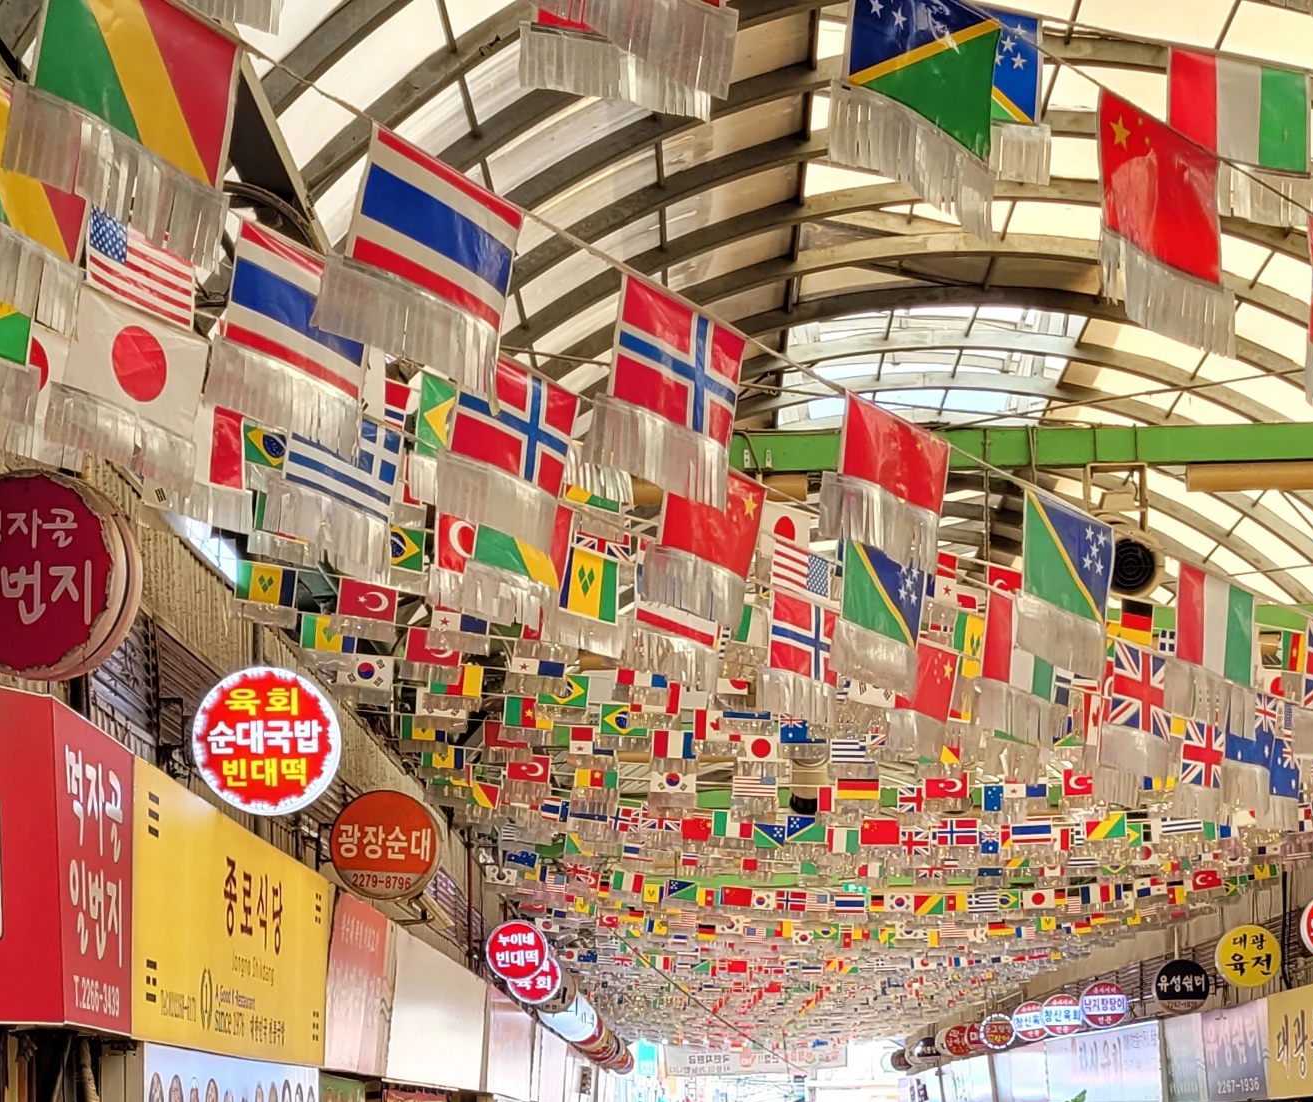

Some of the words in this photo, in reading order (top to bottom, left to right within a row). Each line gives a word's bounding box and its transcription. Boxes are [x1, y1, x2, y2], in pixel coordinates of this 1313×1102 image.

[225, 687, 299, 717] 육회
[206, 719, 323, 755] 순대국밥
[221, 756, 308, 788] 빈대떡
[65, 743, 124, 864] 먹자골
[337, 823, 432, 862] 광장순대
[350, 870, 412, 892] 2279-8796
[68, 859, 124, 968] 일번지
[223, 855, 284, 956] 종로식당
[1232, 933, 1267, 951] 대광
[495, 950, 539, 968] 빈대떡
[1225, 952, 1273, 977] 육전
[1157, 973, 1206, 993] 유성쉼터
[1216, 1076, 1260, 1095] 2267-1936
